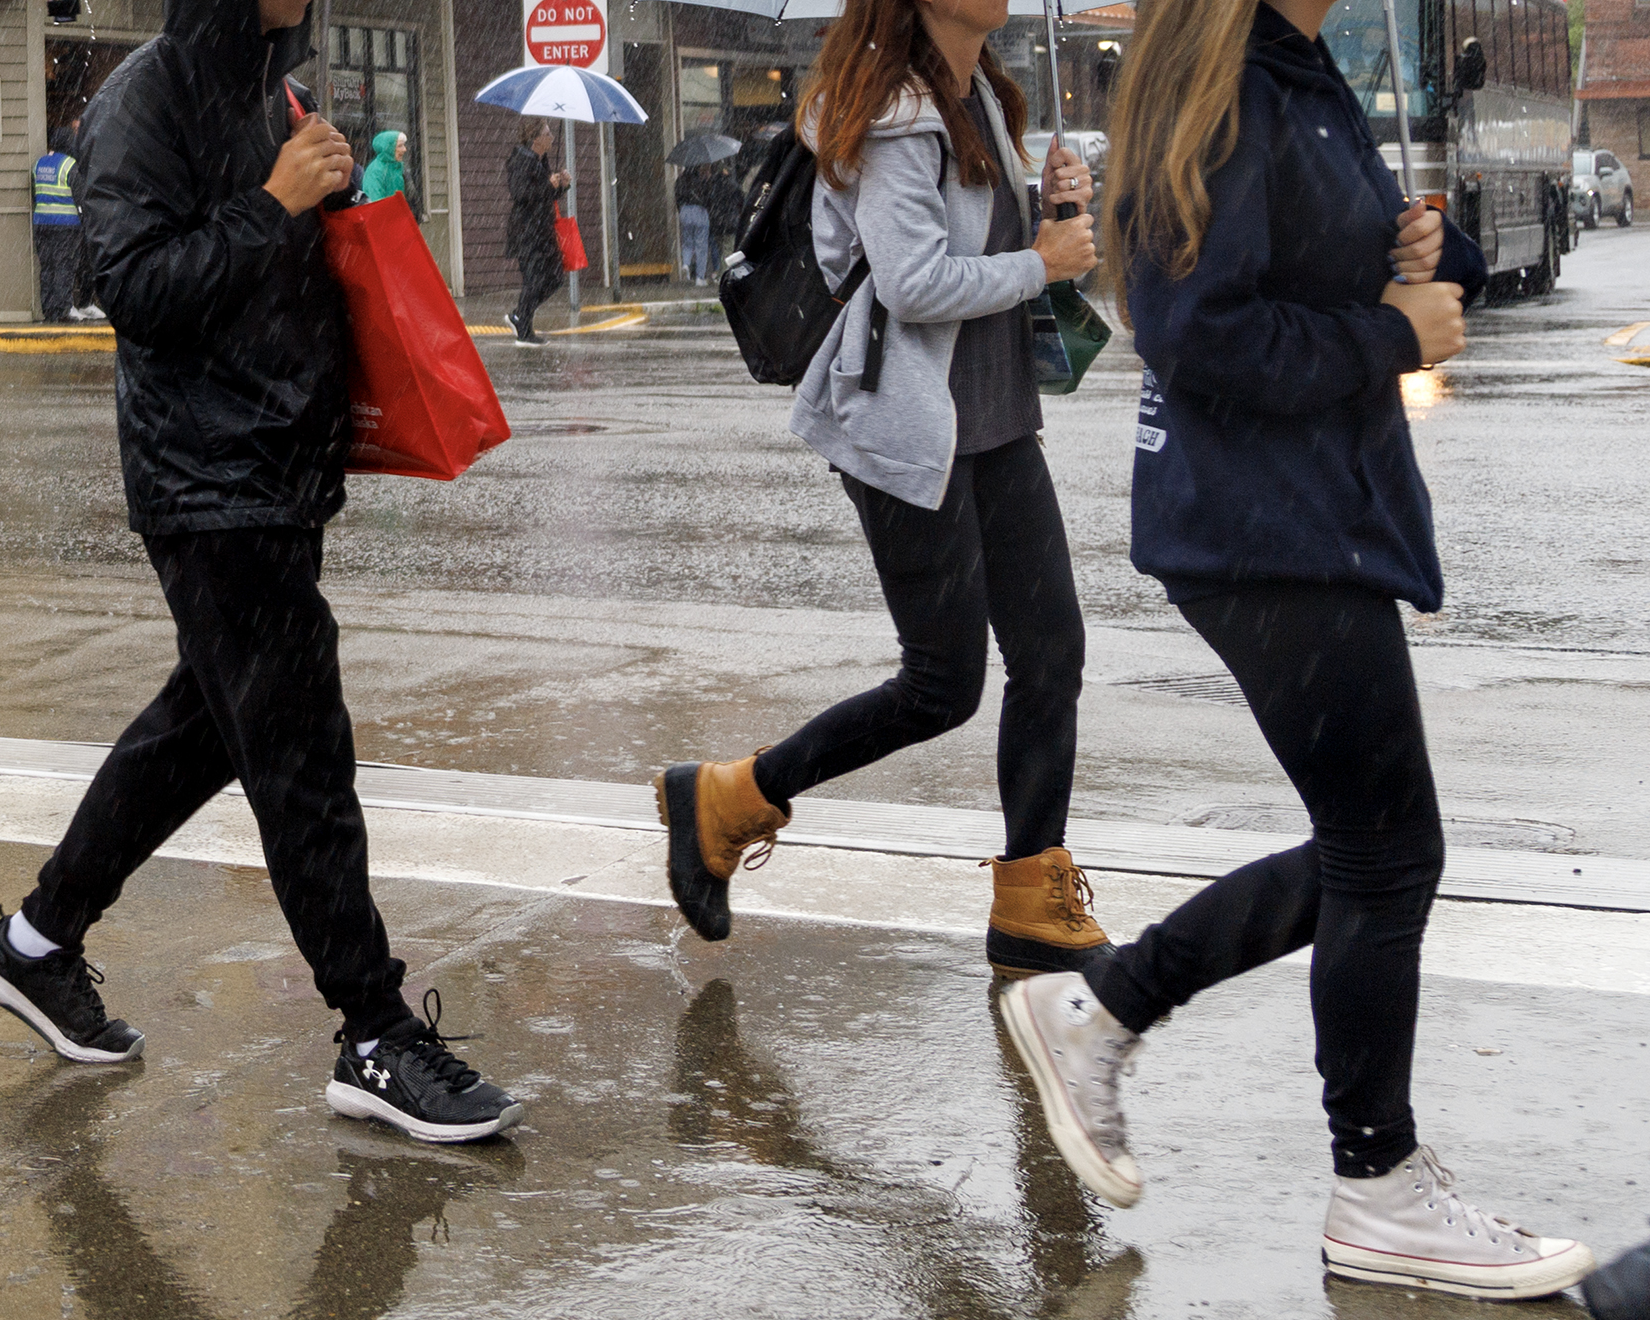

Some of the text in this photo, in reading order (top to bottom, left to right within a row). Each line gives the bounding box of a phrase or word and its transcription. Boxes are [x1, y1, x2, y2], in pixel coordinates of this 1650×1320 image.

[537, 6, 594, 23] DO NOT
[543, 44, 589, 60] ENTER
